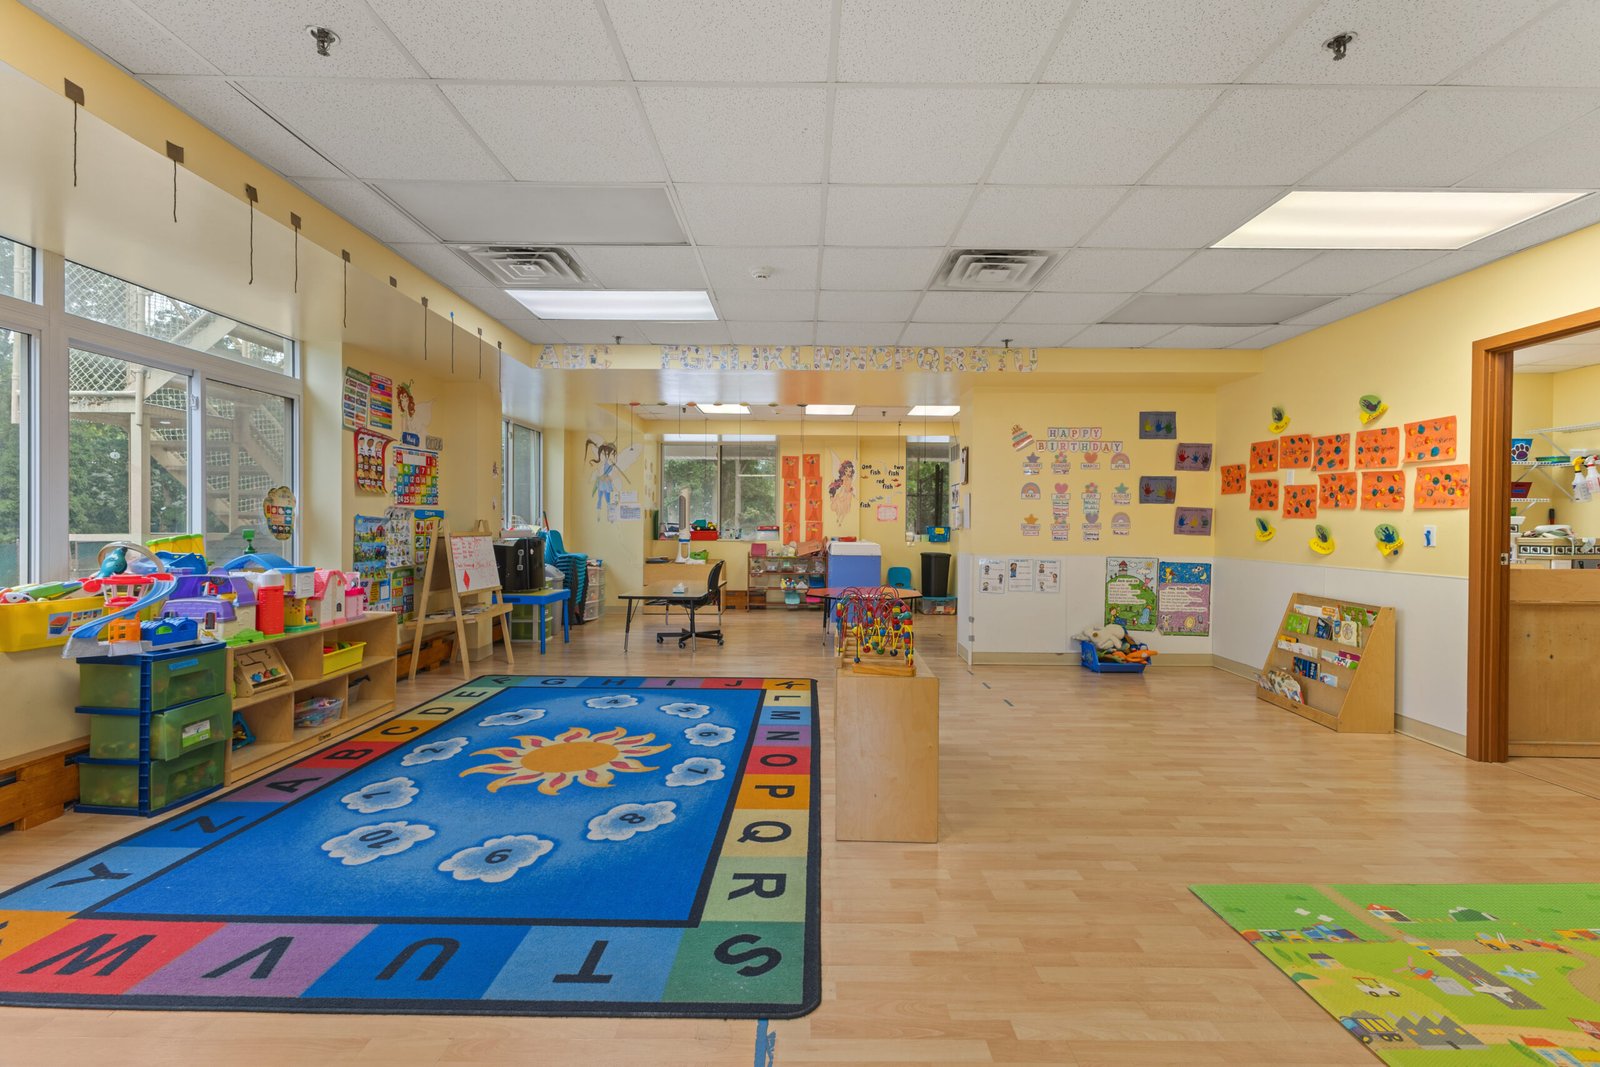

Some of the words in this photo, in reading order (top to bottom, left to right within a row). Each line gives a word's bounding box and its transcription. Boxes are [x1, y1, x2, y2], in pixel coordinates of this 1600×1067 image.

[406, 434, 417, 444] May
[1049, 429, 1100, 438] HAPPY
[1038, 441, 1121, 451] BIRTHDAY
[491, 676, 513, 685] F
[541, 678, 567, 686] G
[601, 678, 625, 686] H
[665, 679, 676, 687] I
[775, 680, 803, 689] K
[453, 690, 490, 699] E
[774, 694, 801, 702] L
[417, 706, 457, 716] D
[769, 710, 801, 721] M
[507, 713, 524, 721] 3
[380, 725, 420, 737] C
[699, 730, 718, 739] 6
[766, 731, 800, 741] N
[323, 748, 373, 763] B
[420, 746, 445, 755] 2
[759, 753, 798, 767] O
[687, 767, 709, 776] 7
[266, 776, 323, 793] A
[361, 789, 391, 800] 1
[754, 784, 795, 799] P
[619, 812, 646, 824] 8
[170, 816, 247, 833] Z
[737, 820, 792, 843] Q
[358, 829, 401, 849] 10
[484, 848, 512, 864] 9
[46, 862, 133, 890] Y
[727, 873, 787, 900] R
[17, 933, 158, 977] W
[200, 936, 295, 979] V
[375, 937, 461, 982] U
[713, 933, 782, 977] S
[552, 940, 613, 984] T
